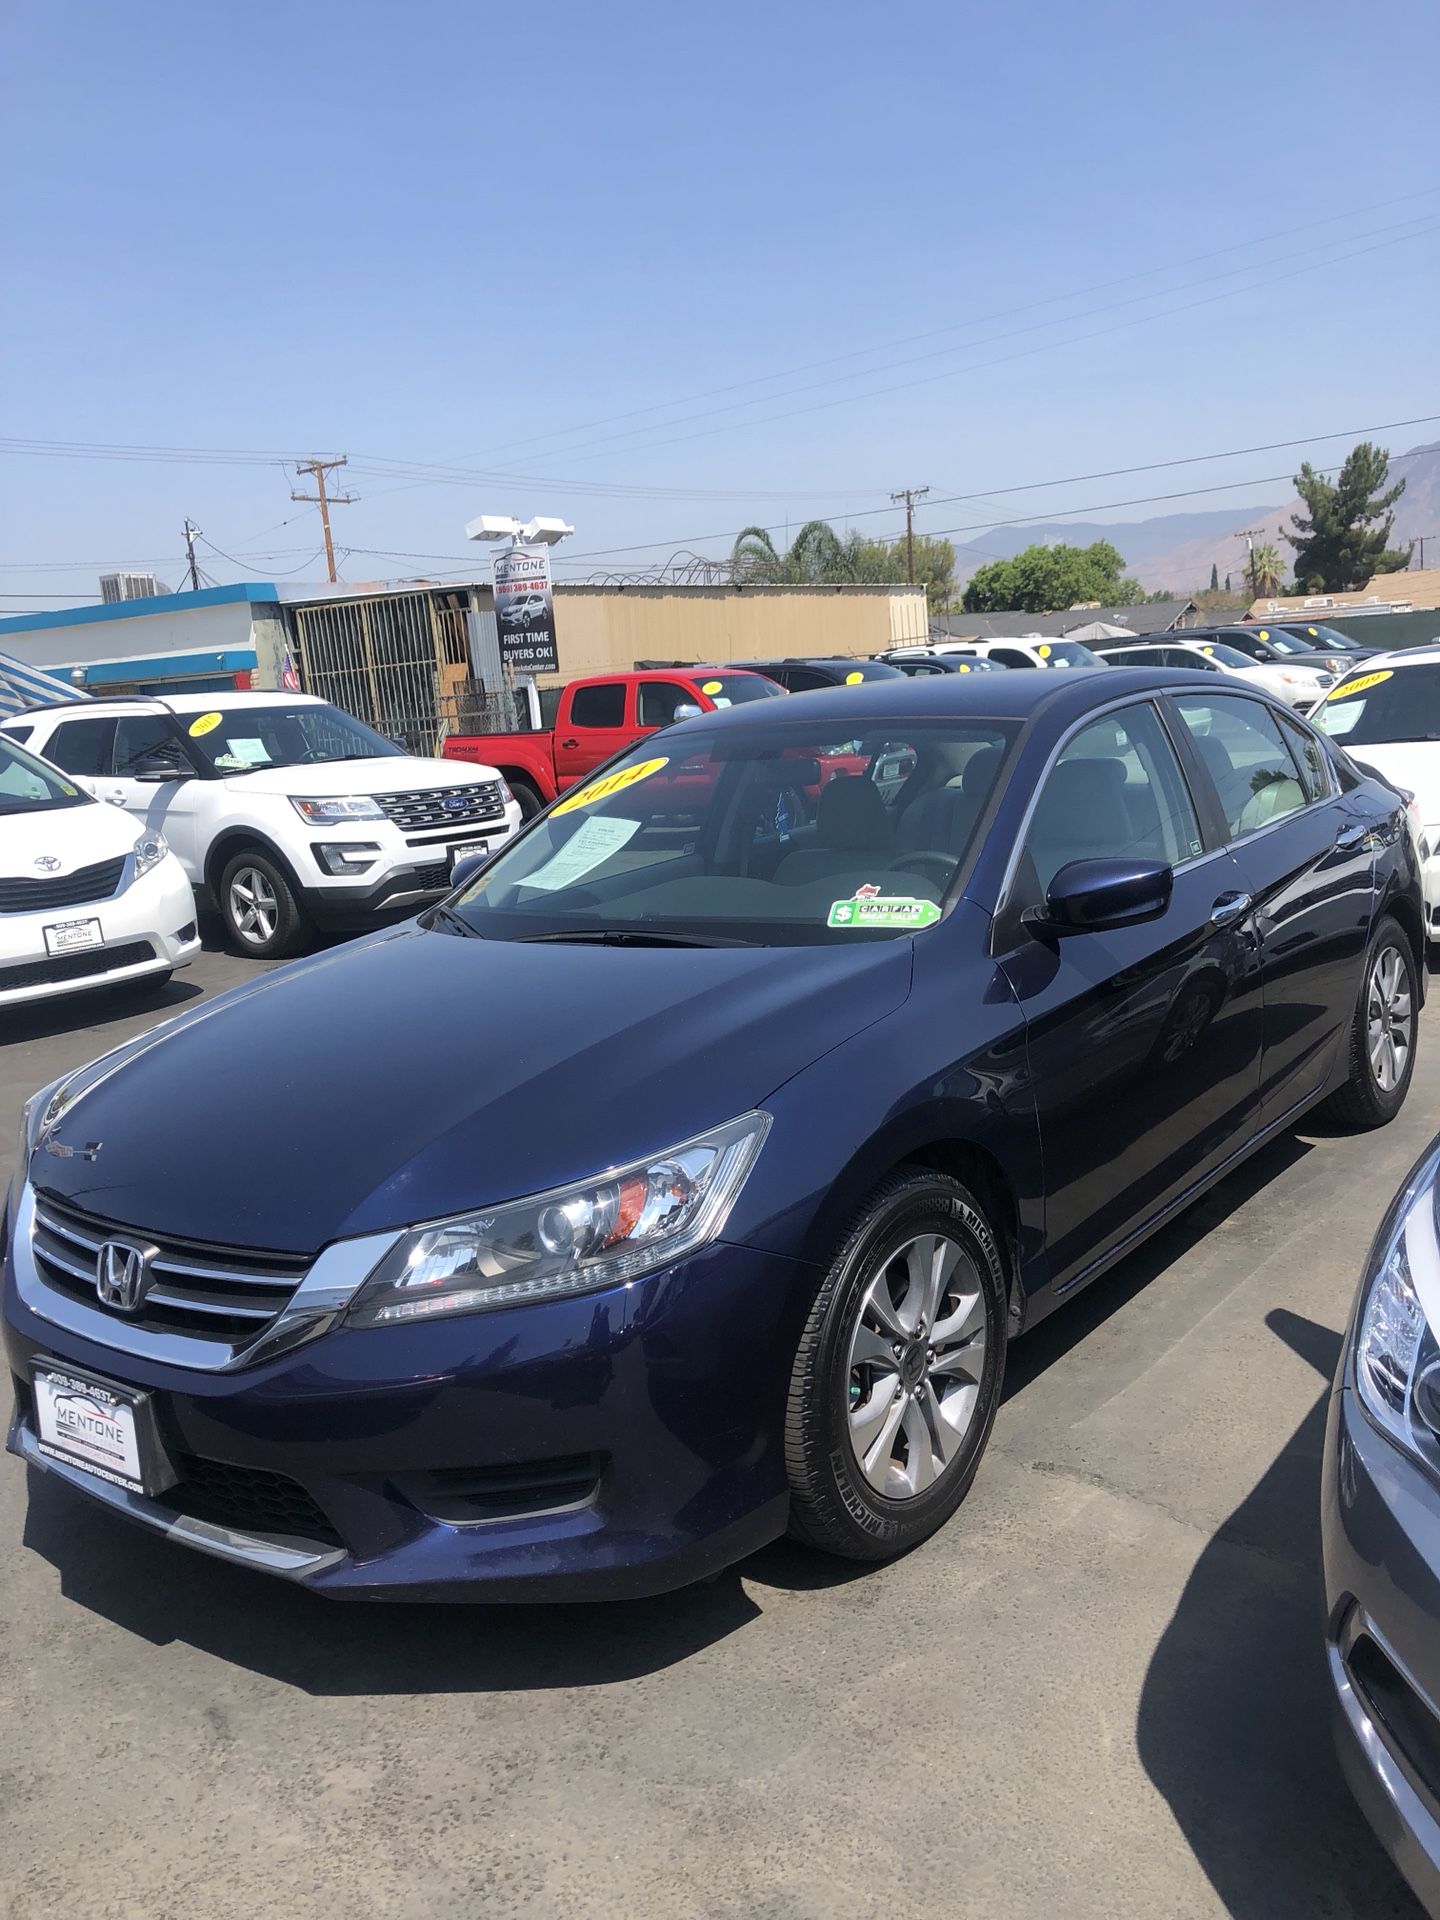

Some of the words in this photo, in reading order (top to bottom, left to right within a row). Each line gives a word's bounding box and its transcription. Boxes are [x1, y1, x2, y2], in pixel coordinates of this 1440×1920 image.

[496, 560, 545, 574] MENTONE
[503, 633, 525, 645] FIRST
[526, 631, 549, 643] TIME
[503, 648, 534, 660] BUYERS
[536, 646, 553, 658] OK!
[566, 763, 649, 811] 2014
[859, 904, 922, 913] CARFAX
[57, 930, 92, 941] MENTONE
[57, 1406, 124, 1444] MENTONE
